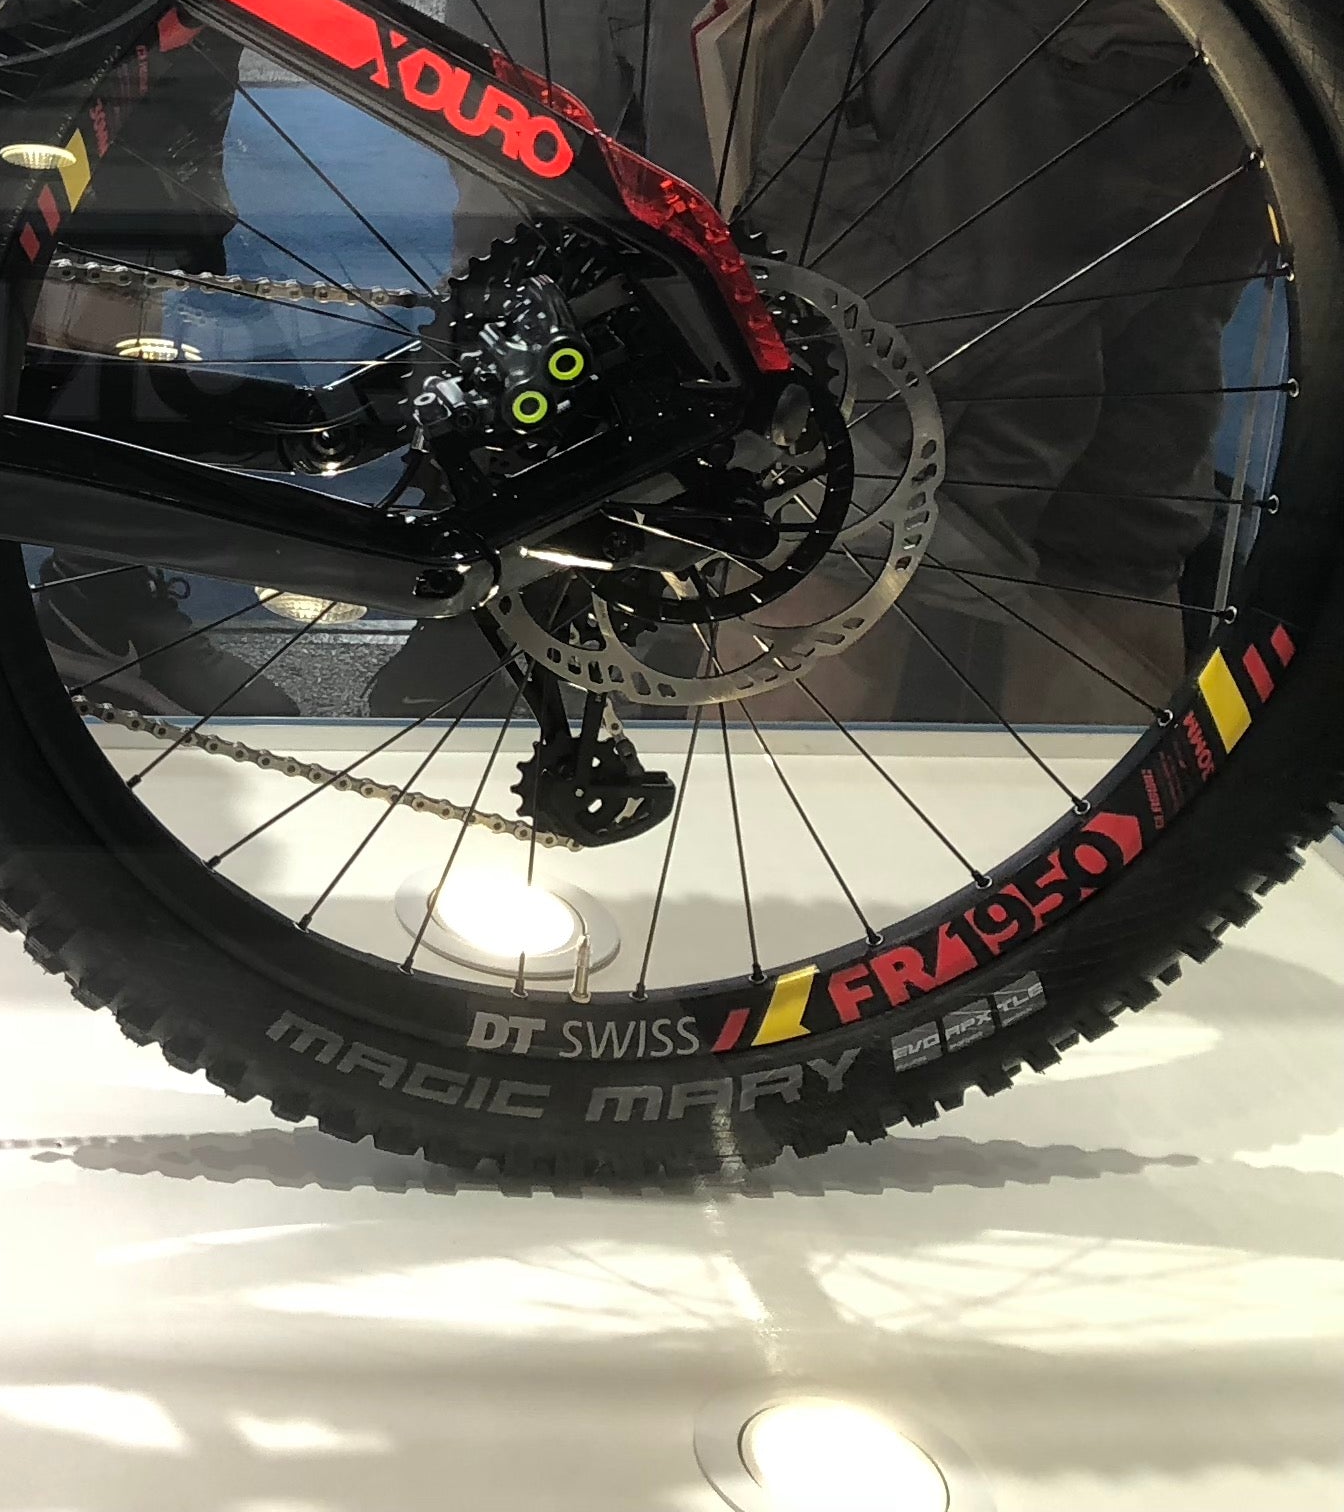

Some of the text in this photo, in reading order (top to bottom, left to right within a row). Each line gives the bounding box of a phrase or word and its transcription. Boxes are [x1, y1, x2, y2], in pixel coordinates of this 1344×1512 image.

[370, 29, 575, 179] XDURO
[265, 1009, 862, 1122] MAGIC MARY
[467, 1011, 701, 1060] DT SWISS
